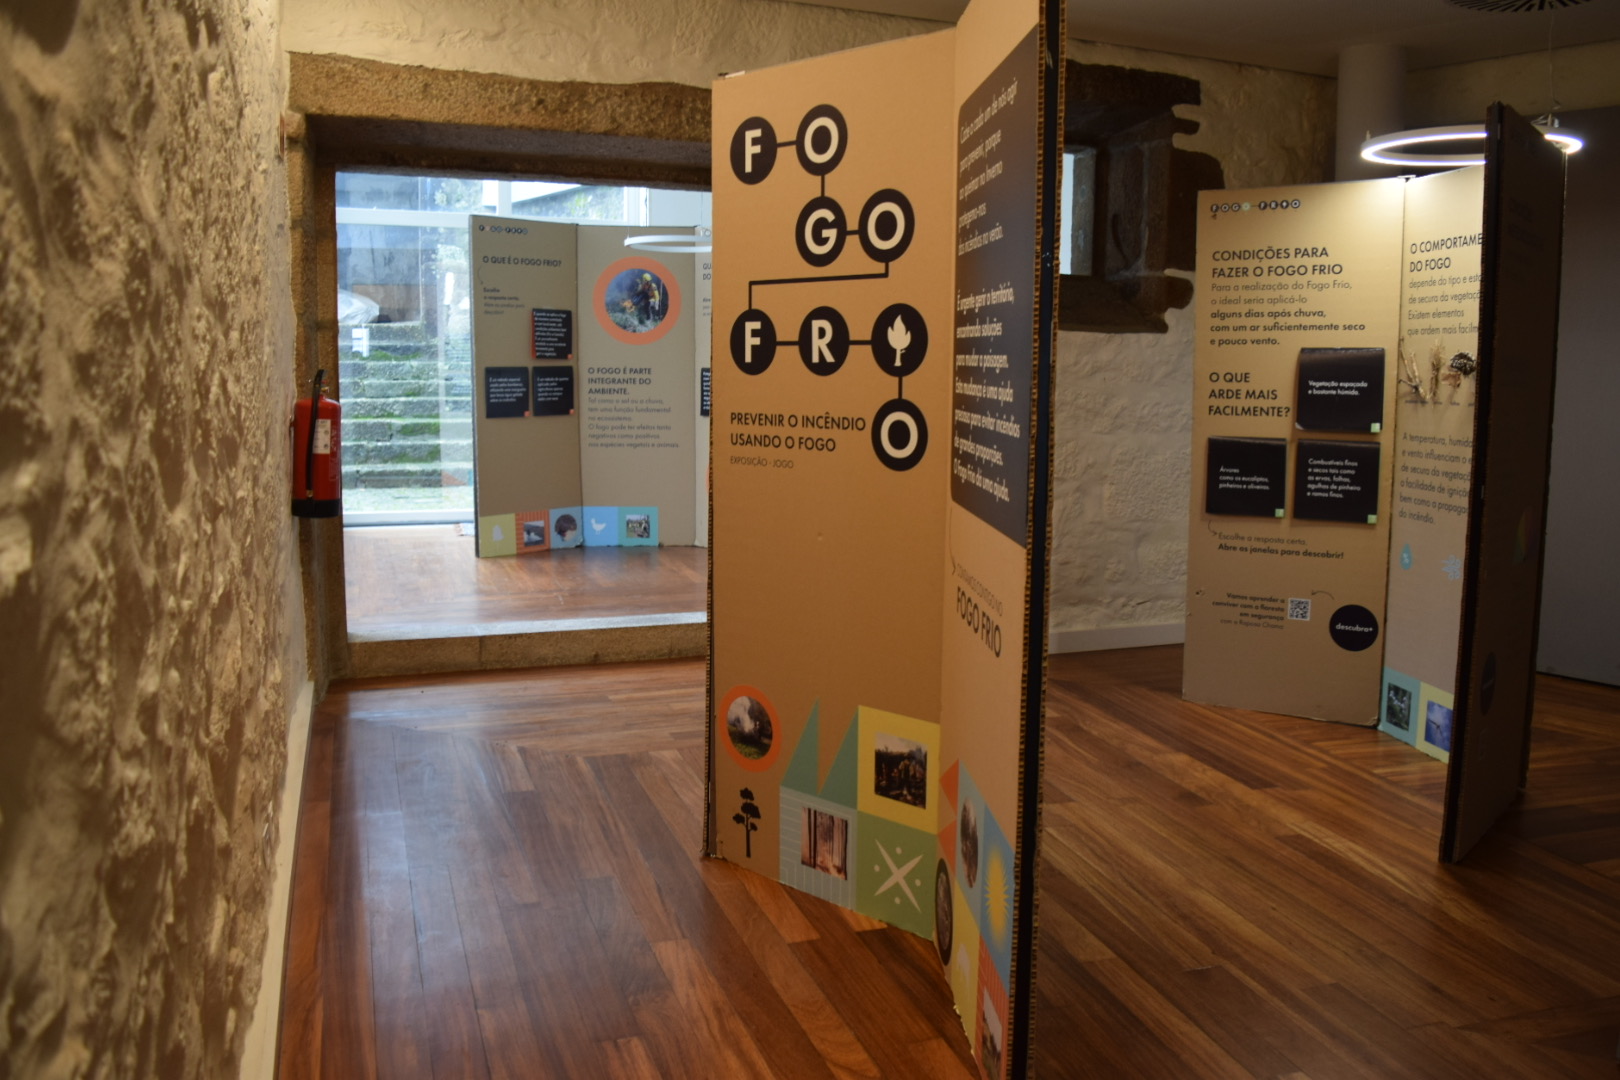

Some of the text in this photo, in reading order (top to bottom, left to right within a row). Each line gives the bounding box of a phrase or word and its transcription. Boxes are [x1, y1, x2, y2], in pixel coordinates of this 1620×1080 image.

[1410, 232, 1484, 254] O COMPORTAME
[1212, 246, 1330, 263] CONDIÇÕES PARA
[482, 255, 562, 268] O QUE É O FOGO FRIO?
[1410, 256, 1452, 272] DO FOGO
[1212, 263, 1343, 279] FAZER O FOGO FRIO
[1211, 283, 1231, 292] Para
[1242, 281, 1289, 293] realização
[1291, 281, 1304, 291] do
[1307, 280, 1330, 292] Fogo
[1333, 280, 1352, 290] Frio,
[1409, 276, 1437, 290] depende
[1438, 275, 1447, 286] do
[1448, 275, 1461, 287] tipo
[1469, 273, 1482, 283] esta
[1219, 296, 1241, 305] ideal
[1243, 296, 1264, 305] seria
[1267, 295, 1307, 307] aplicá-lo
[1409, 291, 1449, 304] de secura da
[1210, 308, 1326, 320] alguns dias após chuva,
[1408, 307, 1465, 320] Existem elementos
[1210, 324, 1230, 332] com
[1232, 324, 1247, 332] um
[1263, 322, 1340, 331] suficientemente
[1407, 324, 1457, 337] que ardem mais
[1218, 338, 1248, 347] pouco
[1250, 337, 1280, 345] vento.
[588, 367, 595, 375] O
[596, 367, 621, 375] FOGO
[623, 365, 627, 375] É
[1209, 371, 1250, 383] O QUE
[1208, 389, 1278, 400] ARDE MAIS
[1208, 405, 1290, 418] FACILMENTE?
[730, 411, 866, 432] PREVENIR O INCÊNDIO
[879, 410, 919, 460] O
[1403, 432, 1447, 447] A temperatura,
[730, 433, 836, 452] USANDO O FOGO
[730, 456, 795, 470] EXPOSIÇÃO JOGO
[1218, 532, 1245, 541] Escolhe
[1253, 536, 1284, 545] resposta
[1286, 537, 1307, 545] certa.
[1218, 543, 1237, 551] Abre
[1250, 545, 1279, 555] janelas
[1302, 549, 1344, 559] descobrir!
[956, 584, 1002, 659] FOGO FRIO
[1251, 612, 1284, 621] segurança
